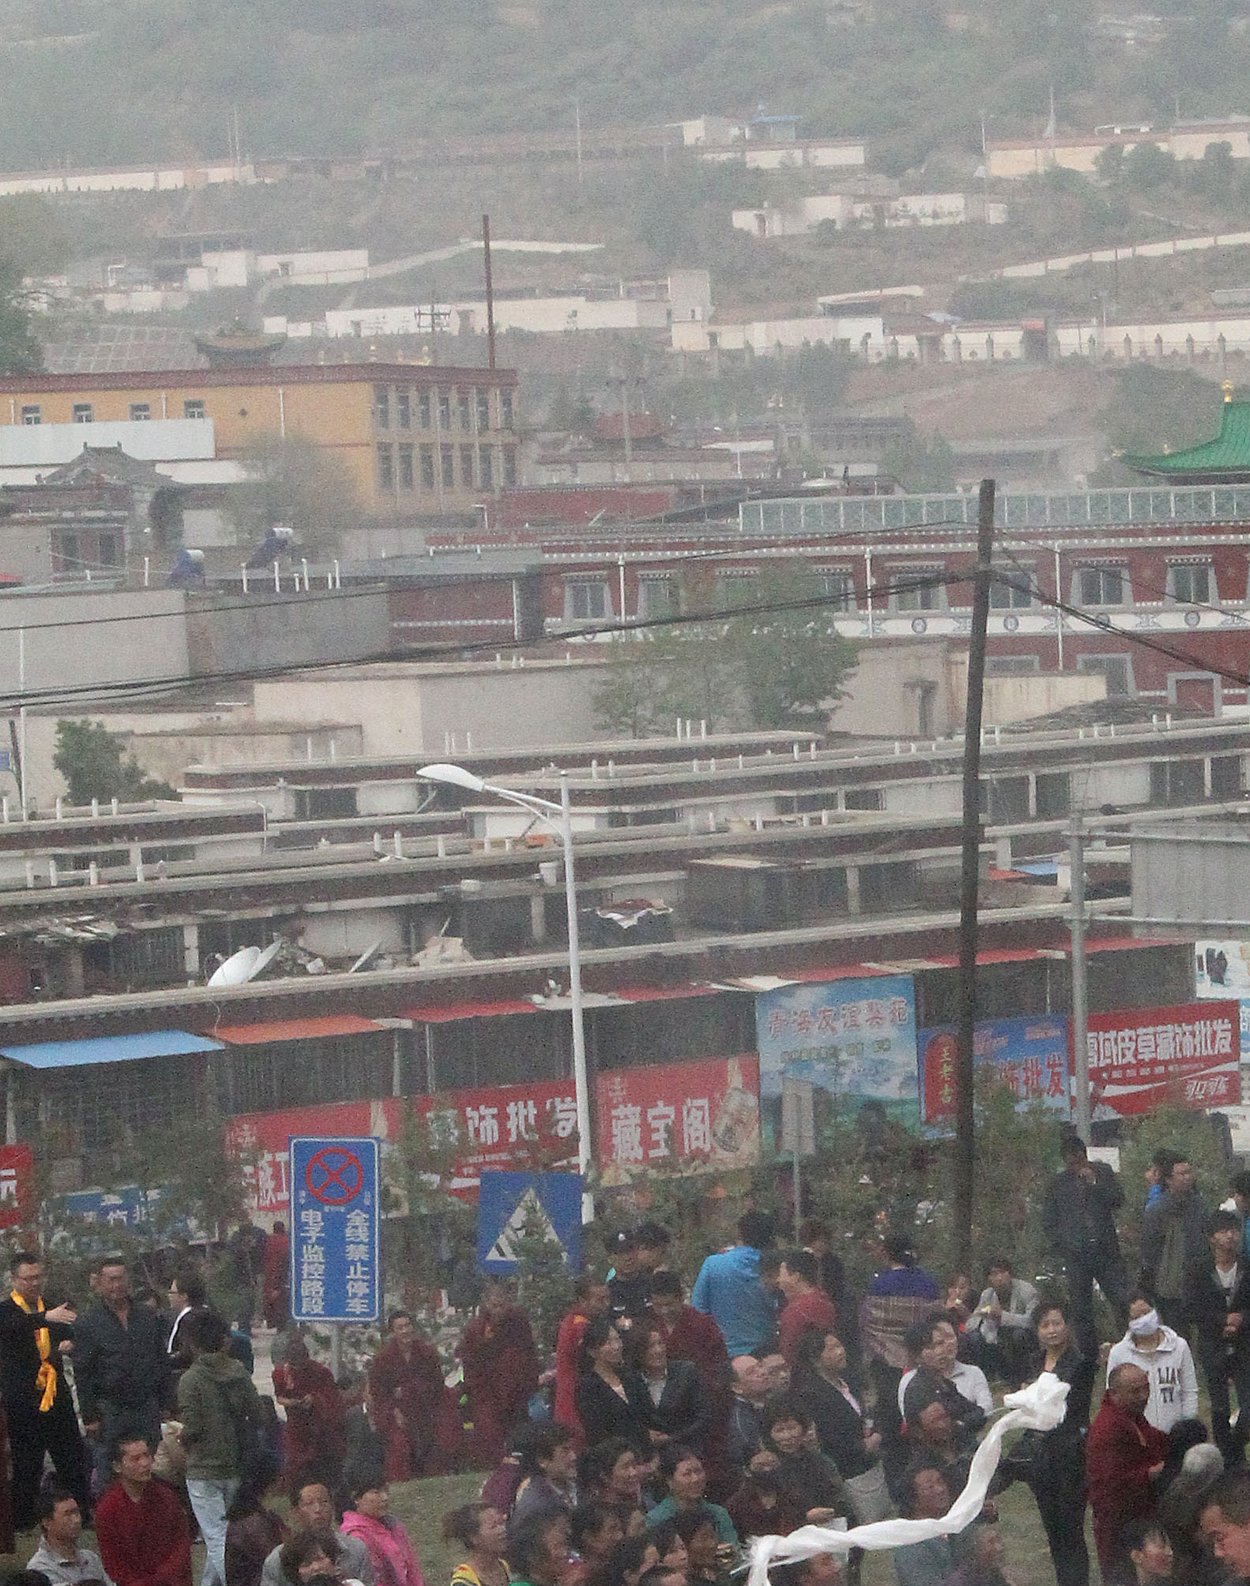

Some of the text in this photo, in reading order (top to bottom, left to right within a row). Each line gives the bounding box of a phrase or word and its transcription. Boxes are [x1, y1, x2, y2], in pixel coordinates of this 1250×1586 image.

[300, 1209, 325, 1314] 电子监控路段
[345, 1209, 370, 1314] 全线禁止停车
